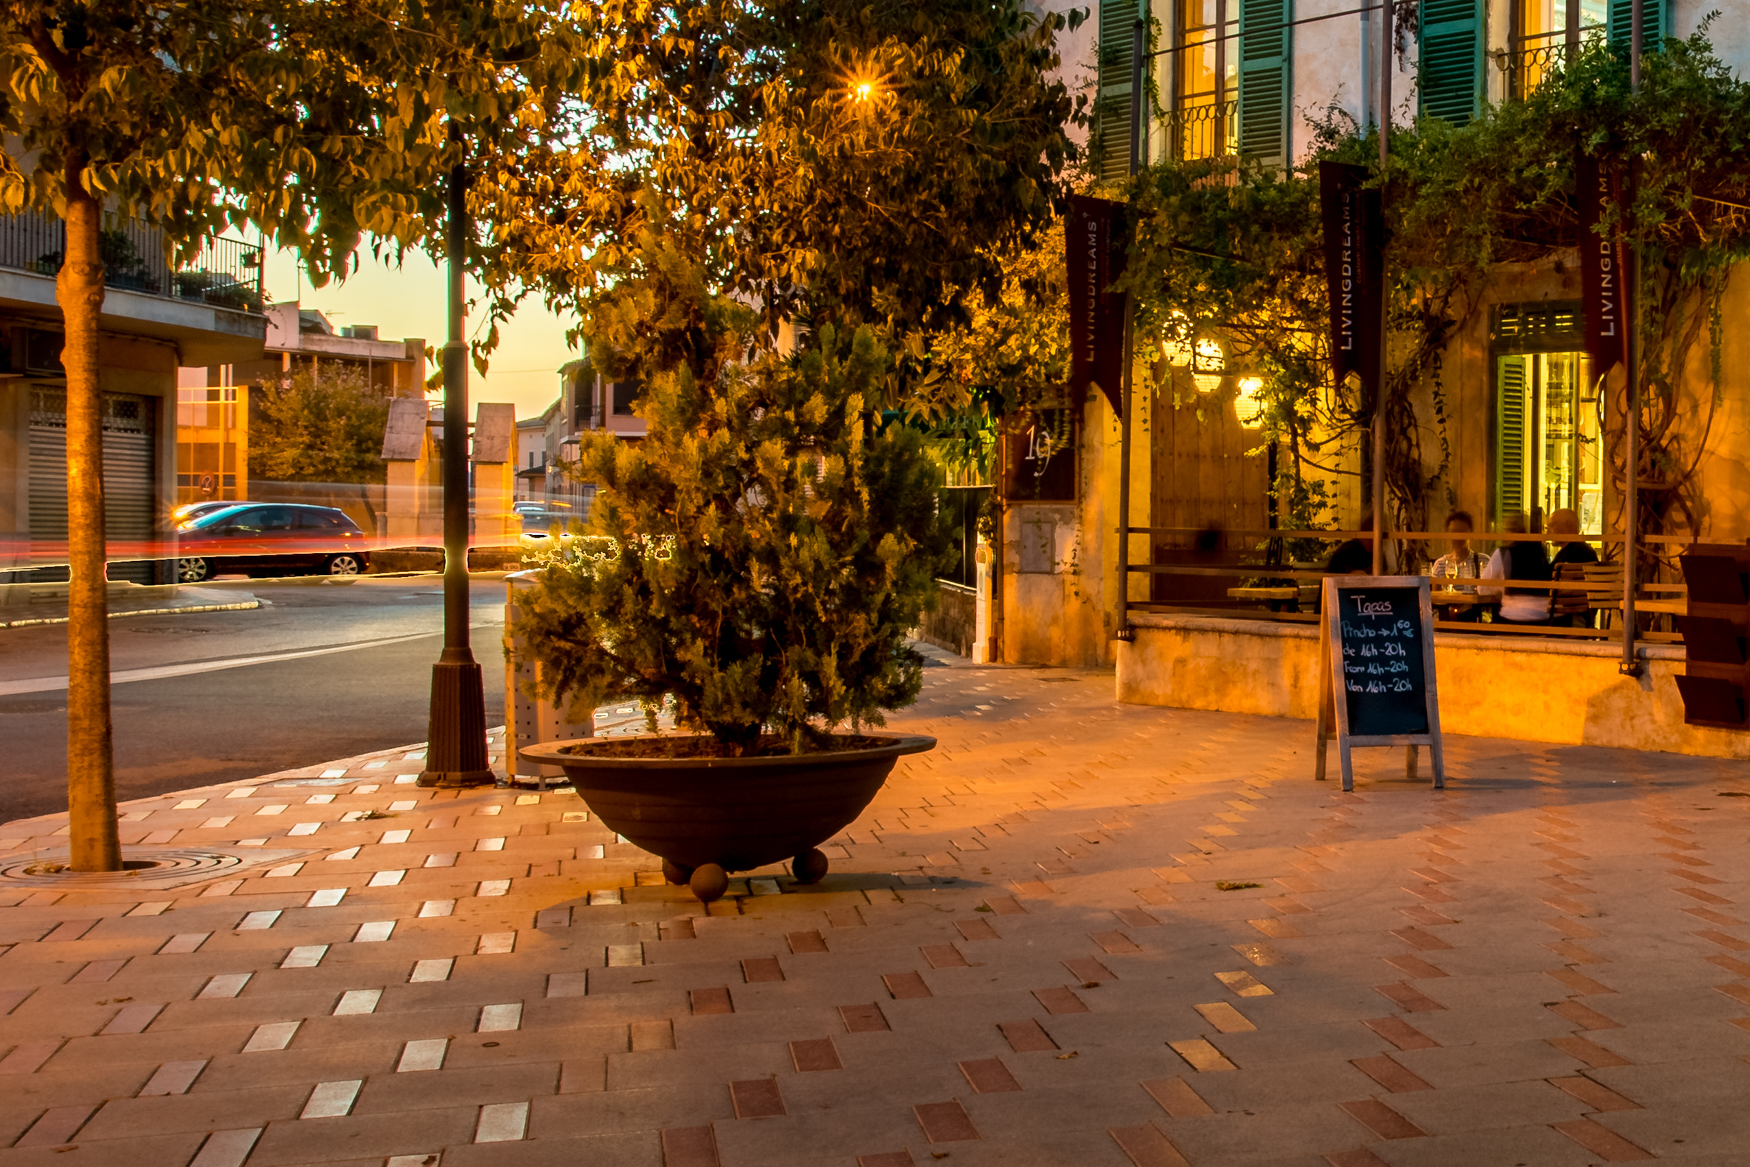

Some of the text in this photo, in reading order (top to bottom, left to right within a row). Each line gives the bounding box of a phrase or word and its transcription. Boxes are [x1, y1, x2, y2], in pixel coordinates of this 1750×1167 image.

[1598, 161, 1615, 337] LIVINGDEAMS
[1340, 191, 1353, 351] LIVINGDREAMS
[1085, 220, 1098, 363] LIVINGDREAMS
[1024, 424, 1051, 477] 19
[1350, 595, 1393, 620] Tapas
[1341, 620, 1376, 638] Pincho
[1342, 642, 1356, 657] de
[1344, 660, 1365, 673] From
[1346, 678, 1363, 692] Von
